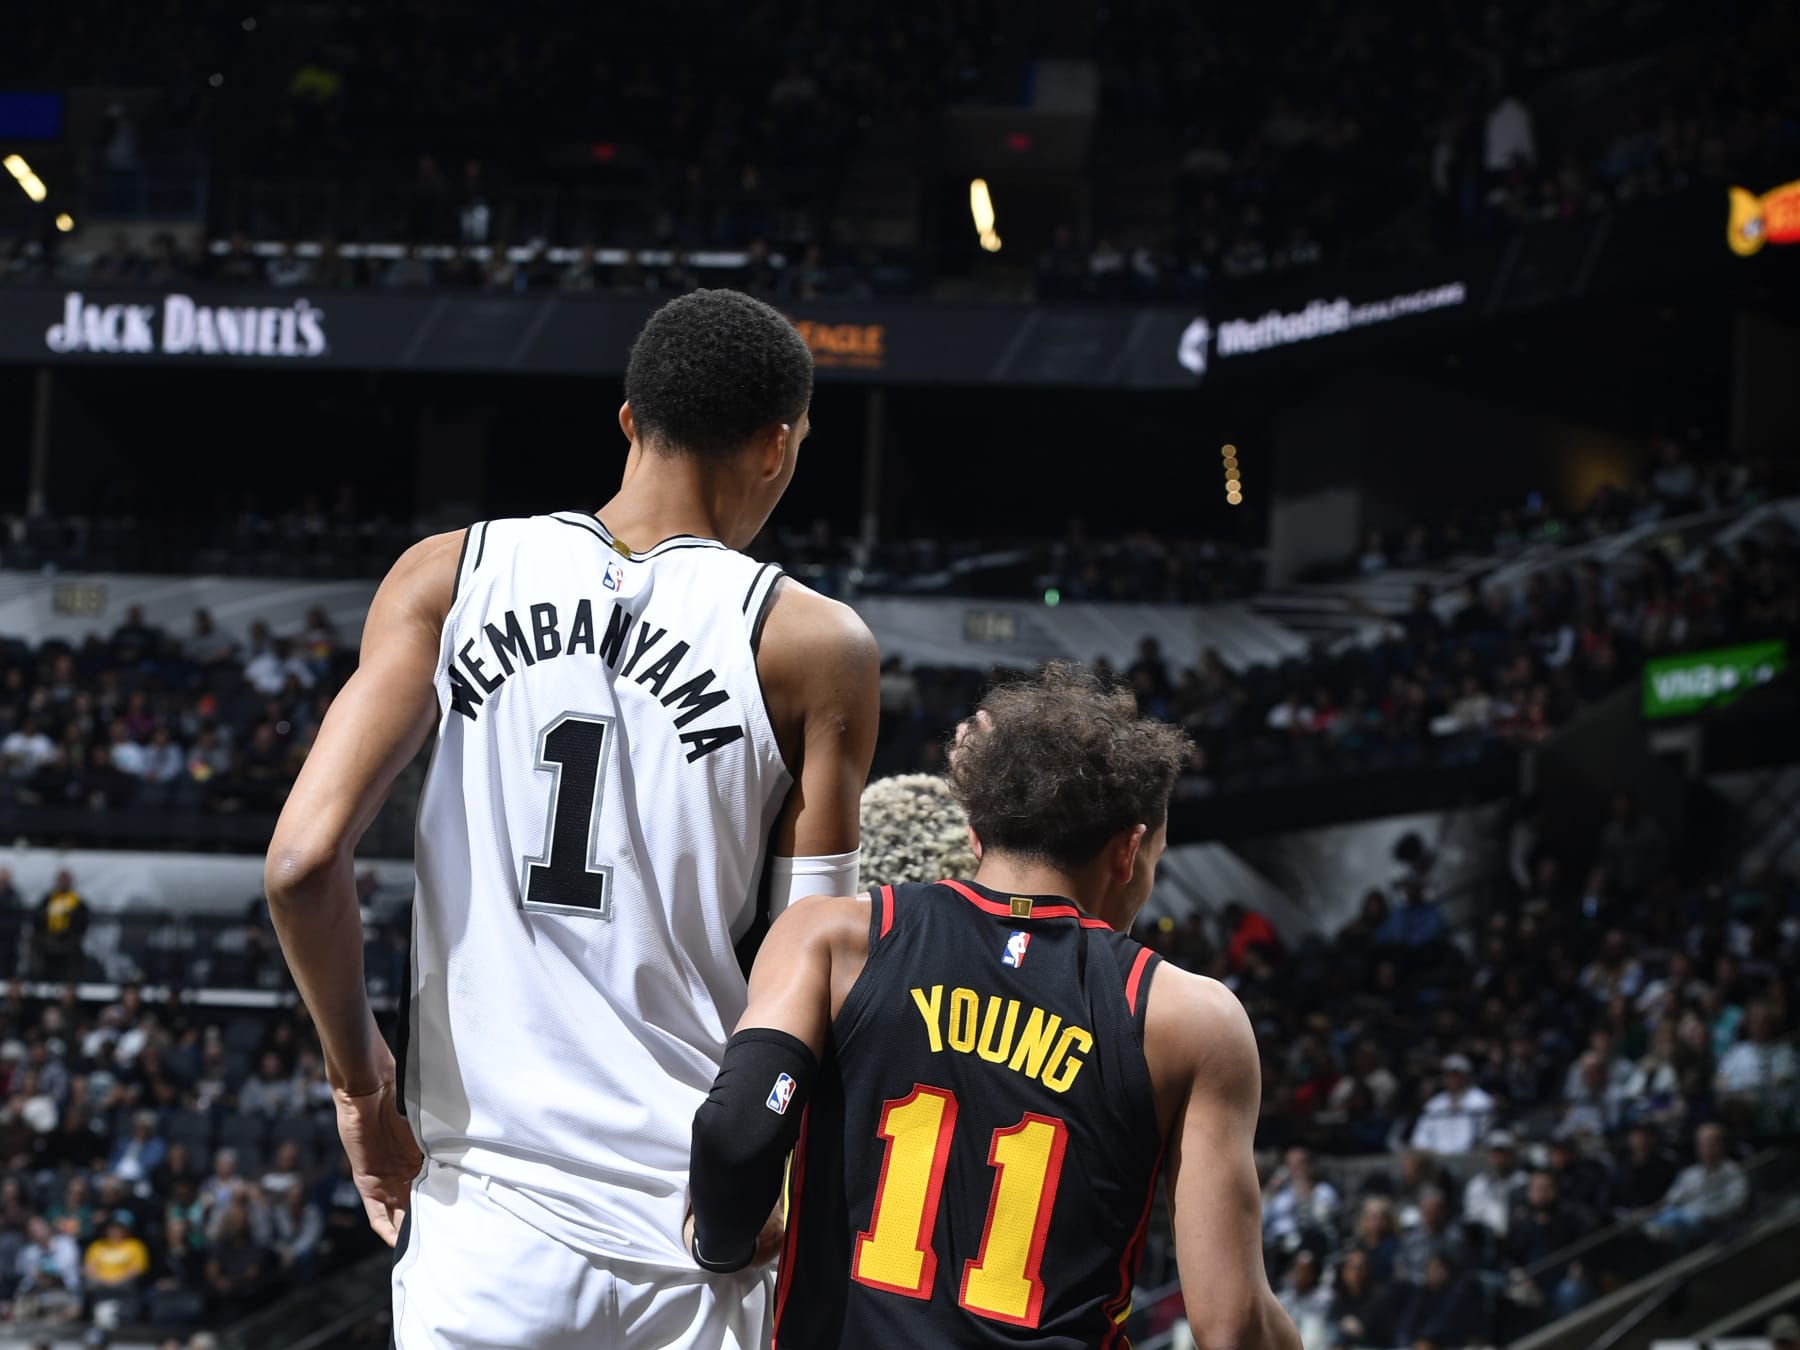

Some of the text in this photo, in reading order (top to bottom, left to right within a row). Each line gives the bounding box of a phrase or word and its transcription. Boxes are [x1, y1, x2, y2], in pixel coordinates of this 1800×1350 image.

[447, 599, 744, 764] WEMBANYAMA
[520, 710, 616, 922] 1
[910, 985, 1093, 1093] YOUNG
[851, 1083, 1069, 1329] 11
